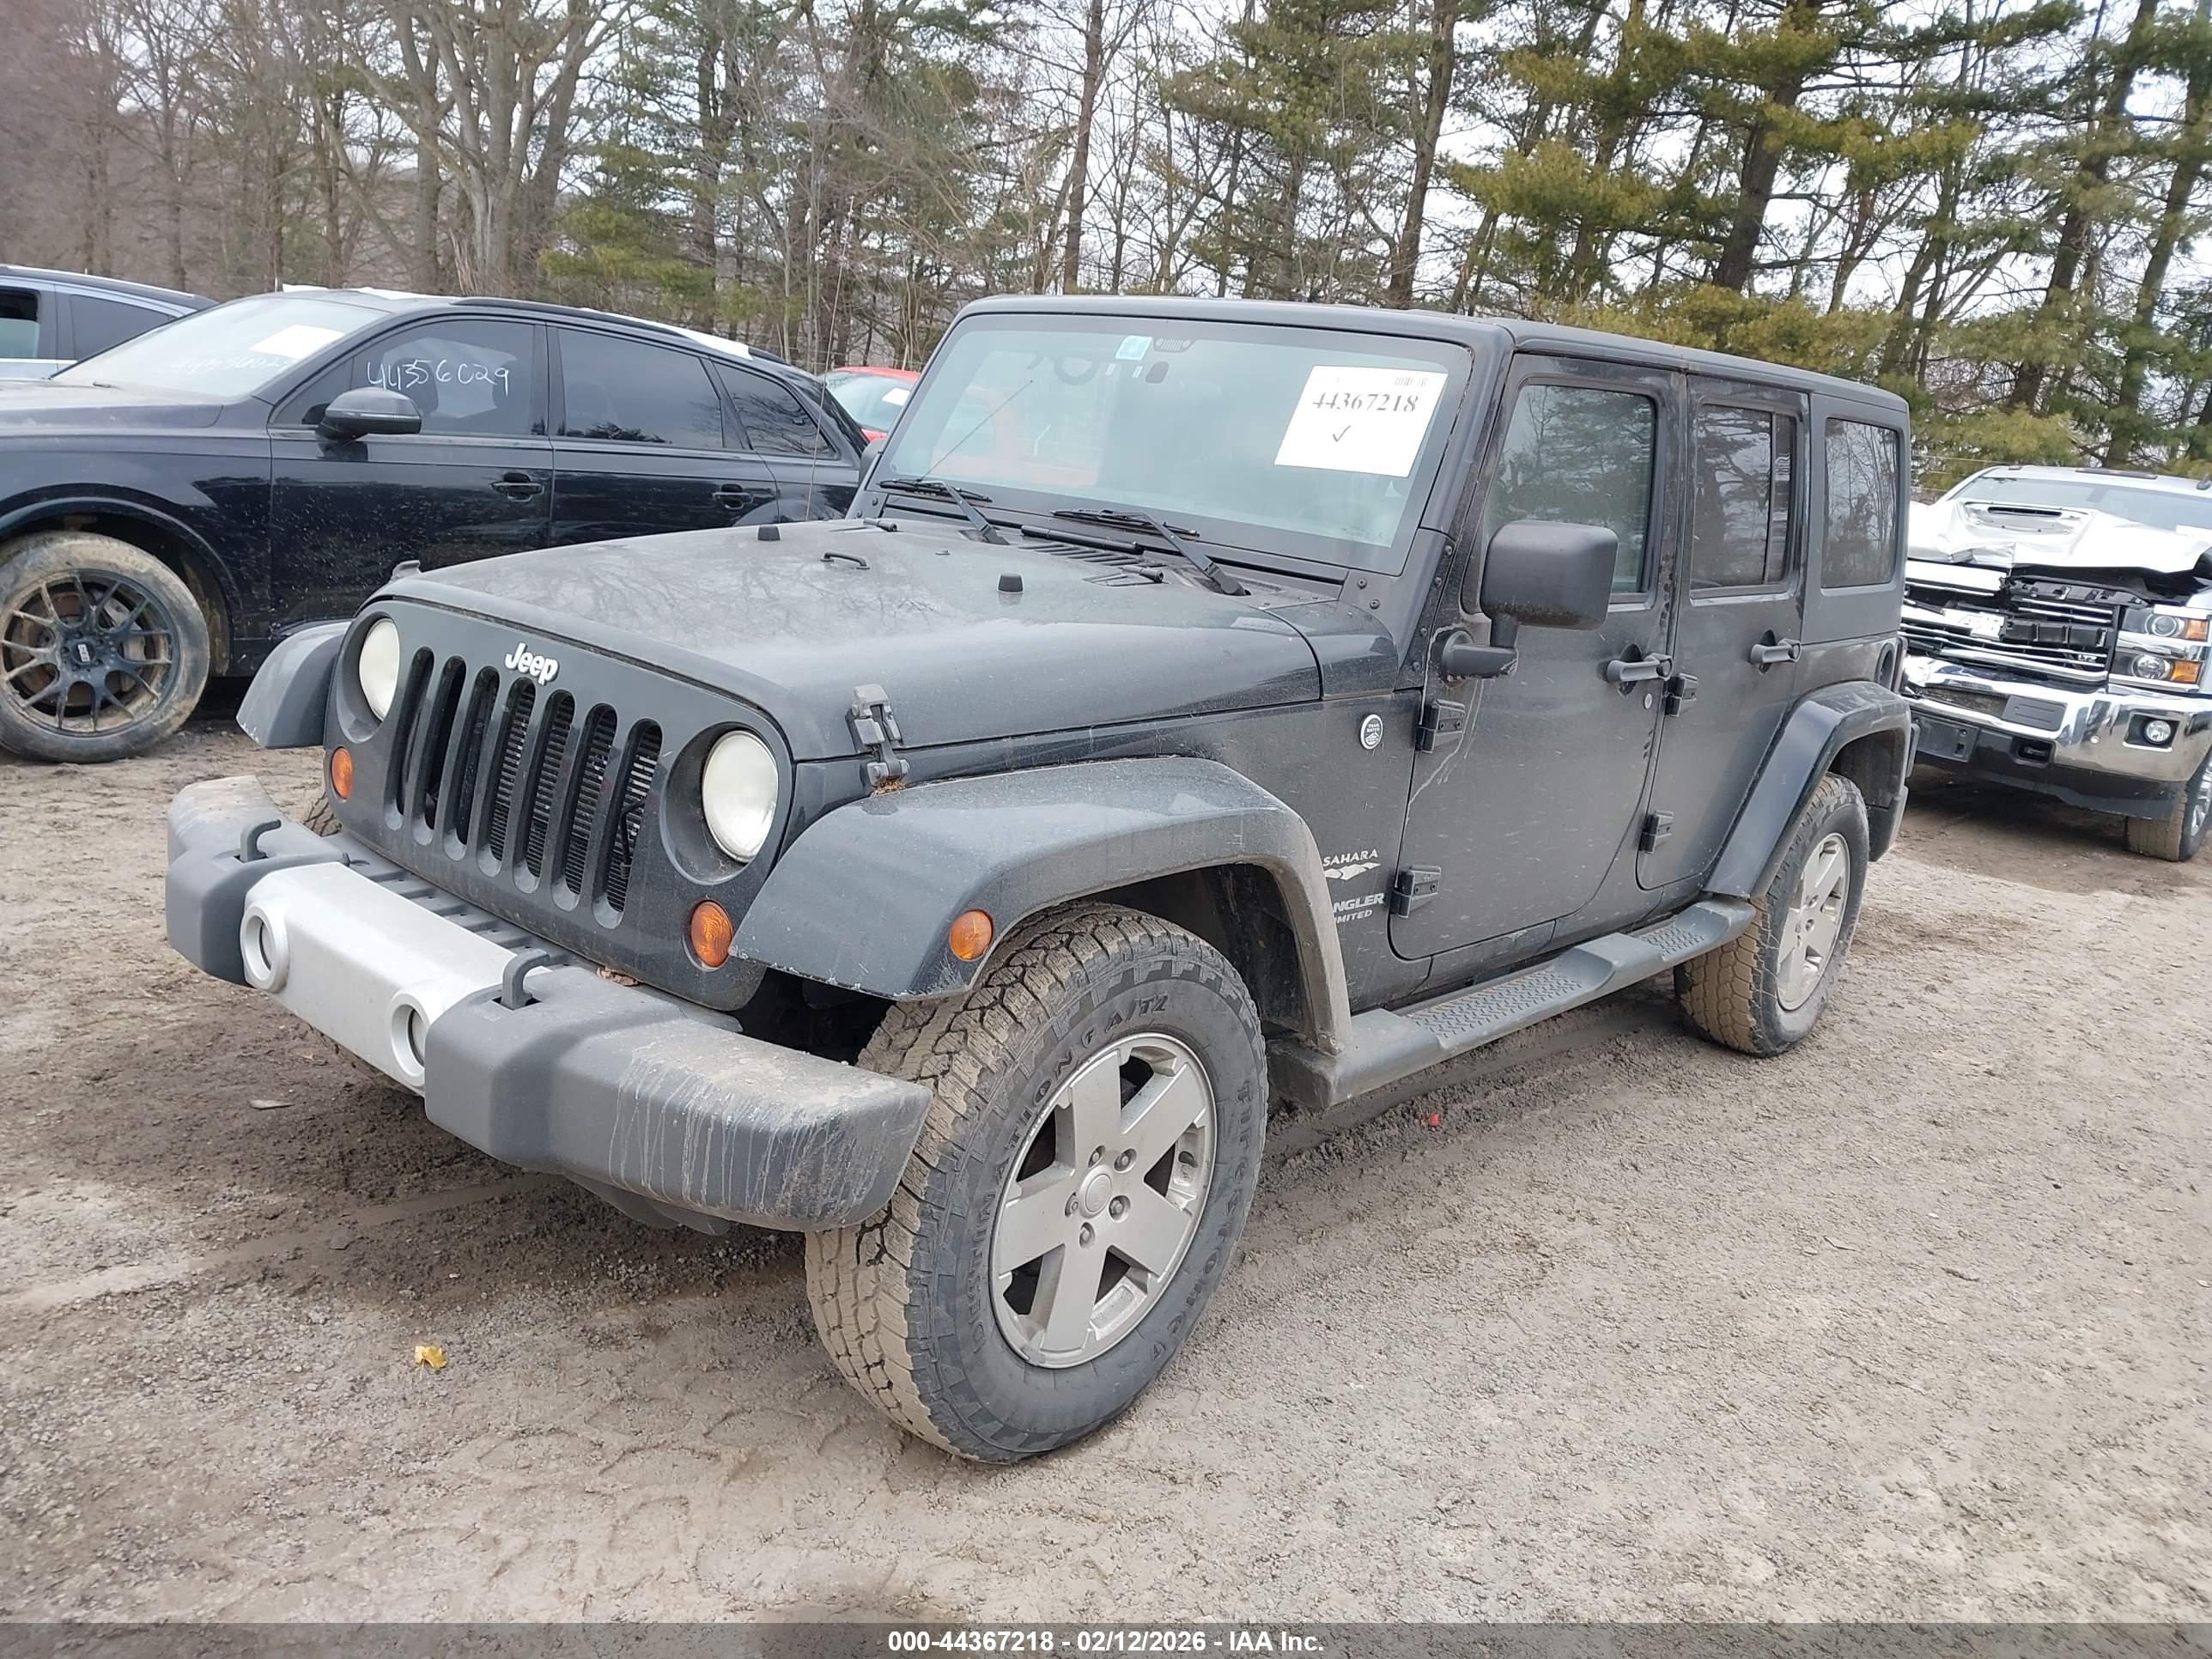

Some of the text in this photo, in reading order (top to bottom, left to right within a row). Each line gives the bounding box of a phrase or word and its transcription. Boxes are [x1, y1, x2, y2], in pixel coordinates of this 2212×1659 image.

[1312, 392, 1419, 412] 44367218
[505, 642, 559, 686] Jeep
[1322, 848, 1378, 866] SAHARA
